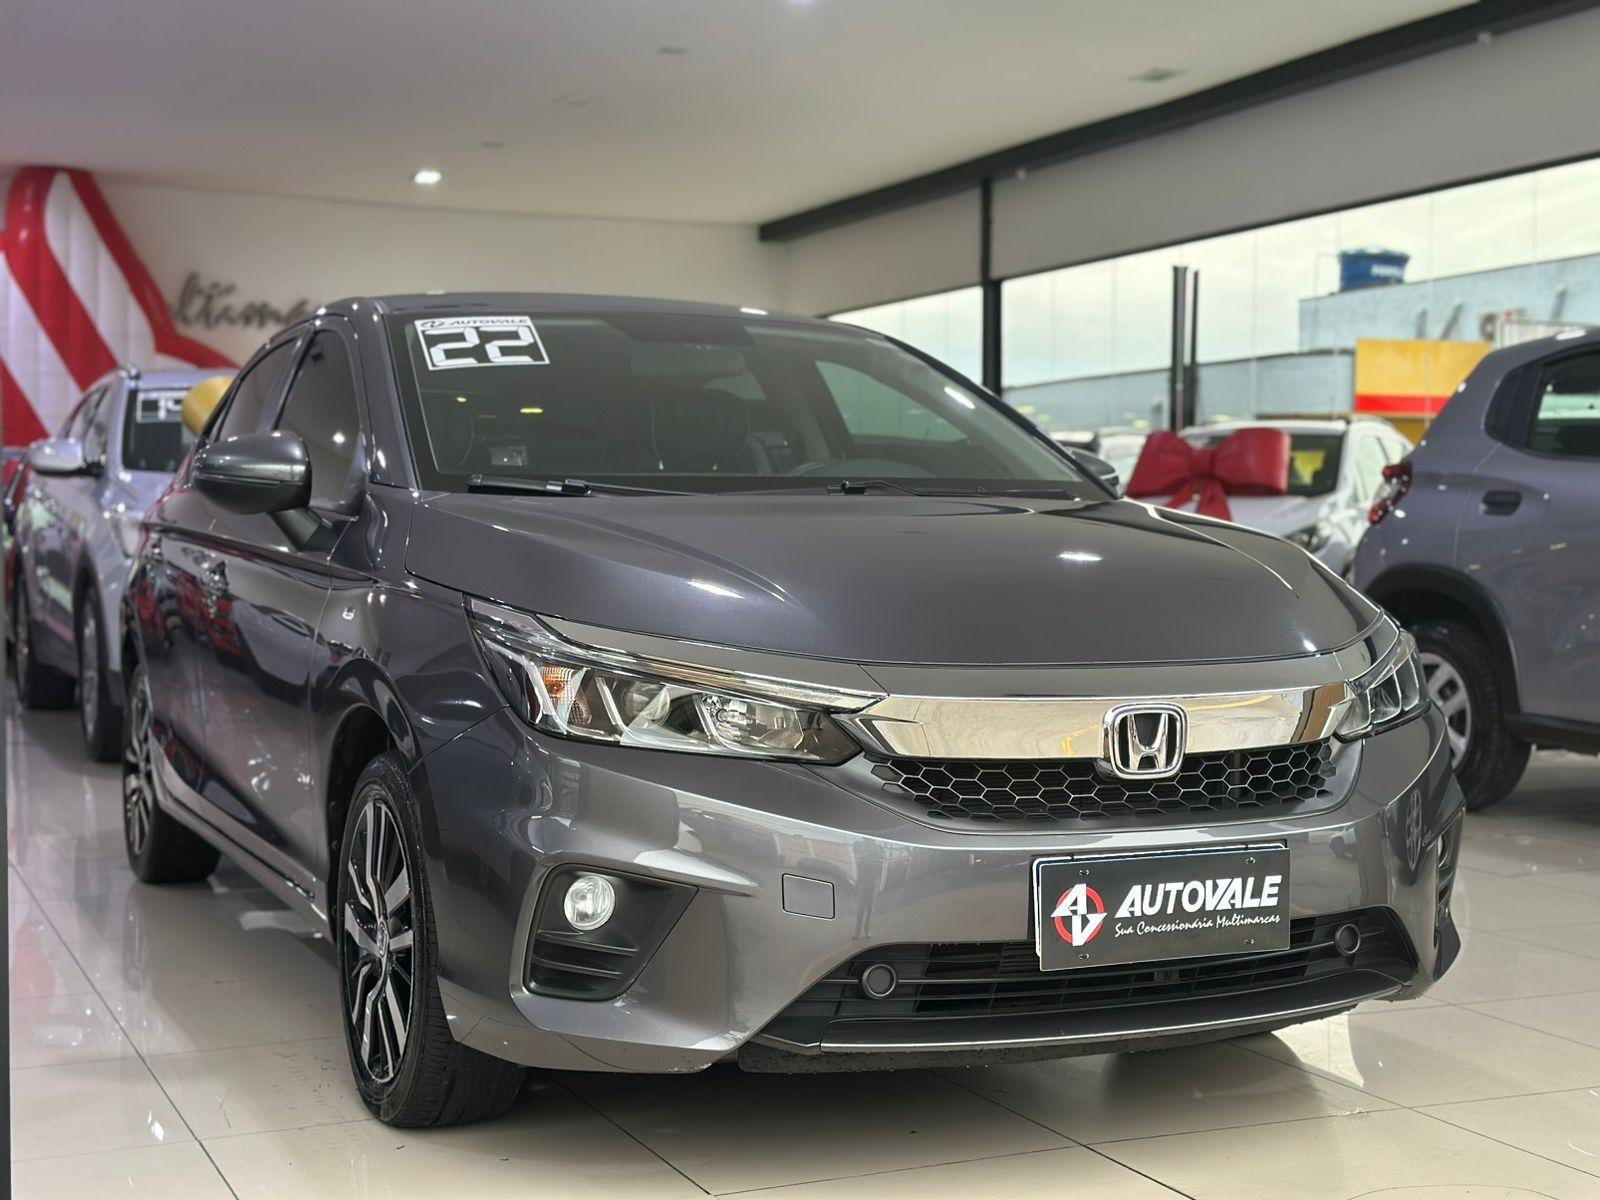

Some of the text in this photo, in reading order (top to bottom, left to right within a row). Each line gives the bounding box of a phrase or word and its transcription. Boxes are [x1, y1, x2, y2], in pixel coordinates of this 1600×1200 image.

[424, 327, 534, 365] 22
[1114, 875, 1282, 919] AUTOVALE
[1114, 913, 1281, 938] Sua Concessionária Multimarcas
